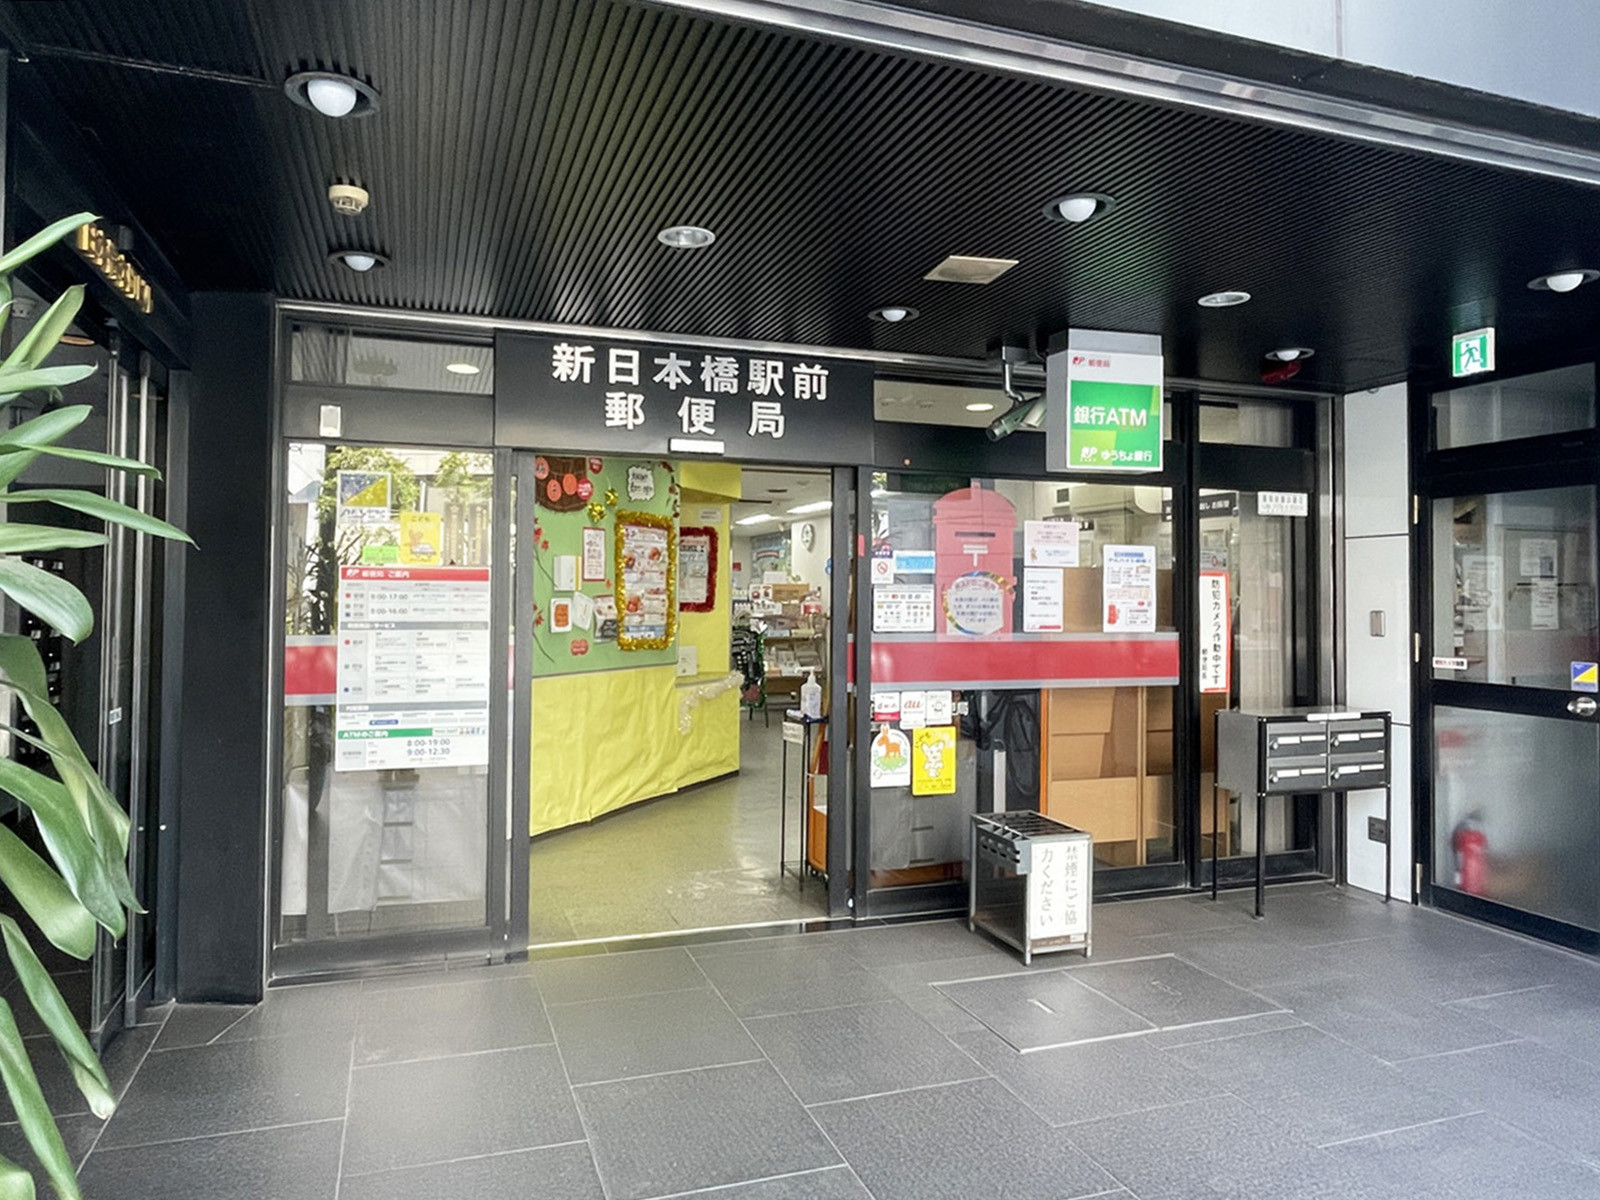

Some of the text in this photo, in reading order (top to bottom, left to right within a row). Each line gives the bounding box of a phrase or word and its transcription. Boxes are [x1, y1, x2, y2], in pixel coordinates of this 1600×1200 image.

[552, 343, 829, 400] 新日本橋駅前
[604, 391, 785, 438] 郵便局
[1073, 406, 1147, 426] 銀行ATM
[1101, 450, 1152, 462] ゆうちょ銀行
[407, 738, 450, 747] 8:00-19:00
[407, 748, 450, 756] 9:00-12:30
[1040, 848, 1054, 927] 力ください
